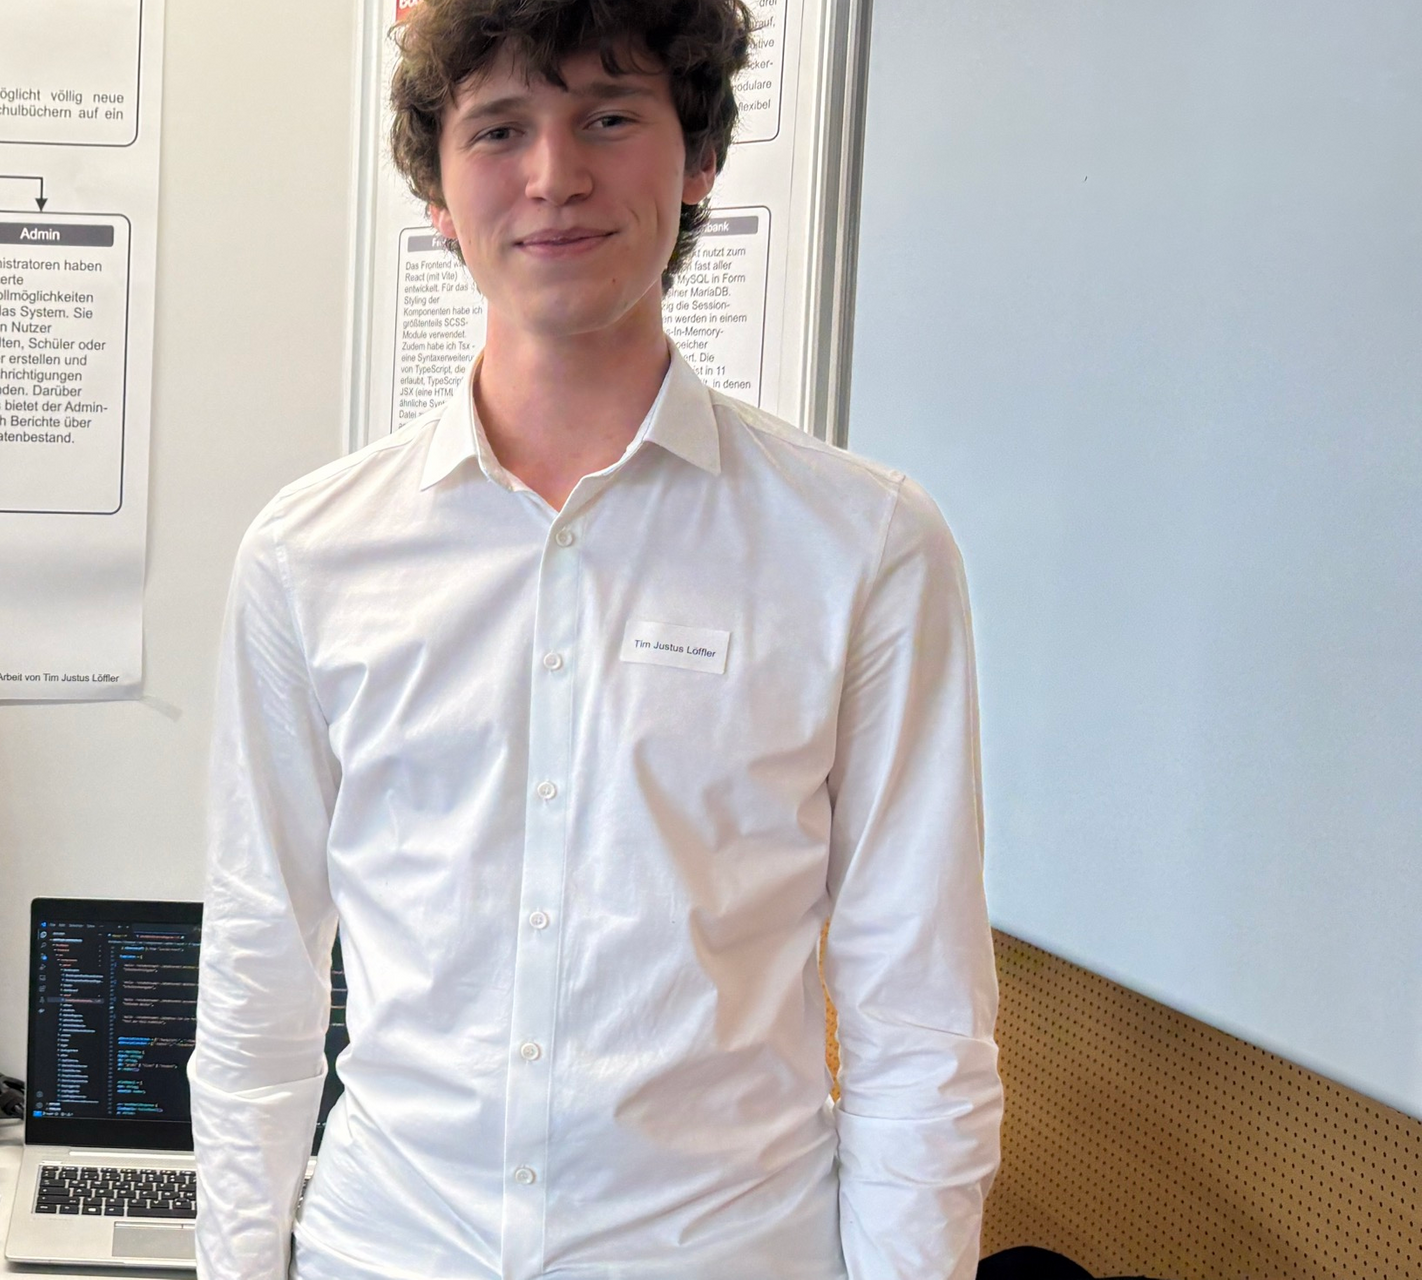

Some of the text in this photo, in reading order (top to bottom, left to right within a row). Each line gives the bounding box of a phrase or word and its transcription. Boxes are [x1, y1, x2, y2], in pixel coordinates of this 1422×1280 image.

[733, 81, 771, 91] odulare
[50, 89, 83, 105] völlig
[92, 93, 124, 103] neue
[738, 99, 770, 111] flexibel
[77, 107, 98, 119] auf
[104, 107, 123, 120] ein
[19, 227, 60, 240] Admin
[702, 248, 725, 257] nutzt
[63, 259, 102, 271] haben
[695, 261, 731, 270] fast aller
[405, 272, 458, 282] React (mit Vite)
[404, 284, 439, 293] entwickelt.
[442, 283, 454, 292] Für
[690, 286, 731, 296] MariaDB.
[404, 296, 426, 306] Styling
[404, 306, 482, 317] Komponenten habe ich
[403, 318, 468, 329] größtenteils SCSS-
[675, 314, 747, 323] werden in einem
[402, 330, 466, 339] Module verwendet.
[27, 337, 75, 350] Schüler
[78, 339, 106, 350] oder
[416, 364, 453, 376] TypeScript,
[454, 365, 465, 373] die
[32, 384, 82, 397] Darüber
[10, 415, 60, 427] Berichte
[63, 416, 92, 428] über
[635, 640, 650, 648] Tim
[654, 642, 684, 653] Justus
[44, 672, 59, 681] Tim
[60, 673, 90, 682] Justus
[91, 673, 119, 682] Löffler
